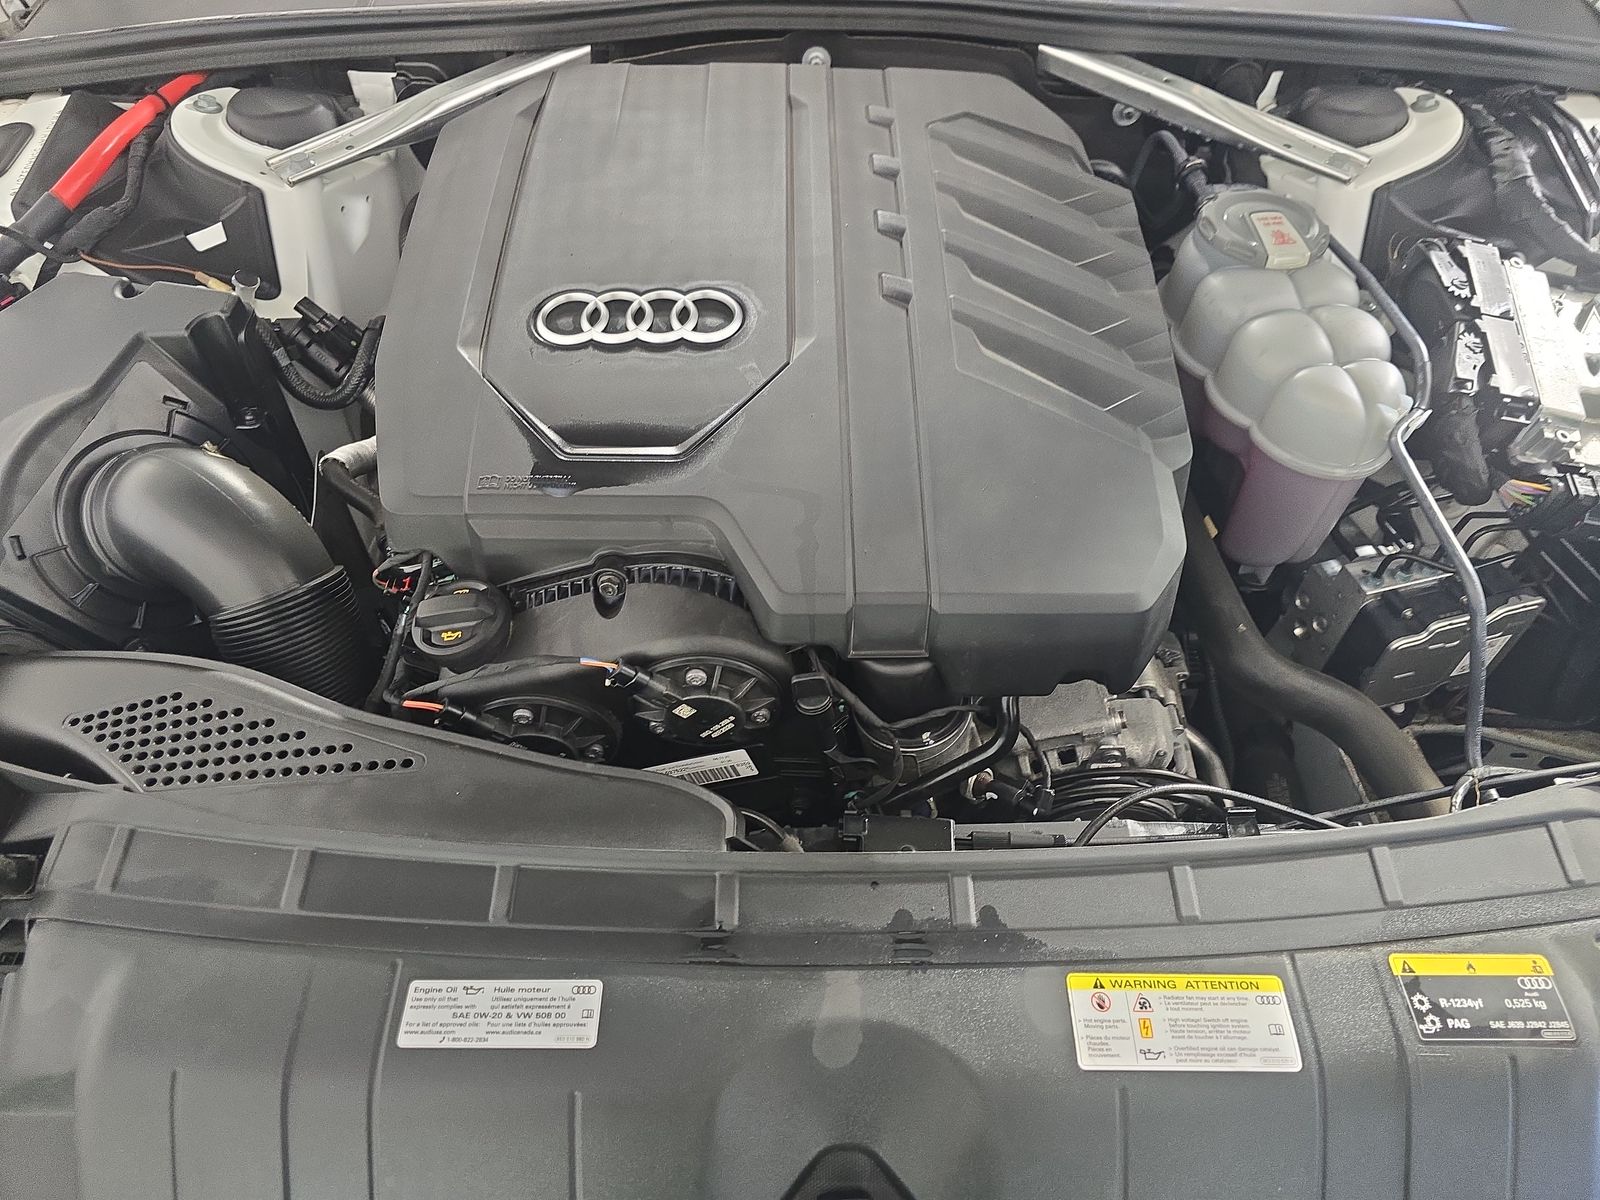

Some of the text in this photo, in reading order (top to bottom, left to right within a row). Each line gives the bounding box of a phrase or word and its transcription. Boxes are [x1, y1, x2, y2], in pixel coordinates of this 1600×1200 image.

[1109, 980, 1260, 990] WARNING ATTENTION
[1438, 998, 1547, 1010] R-1234yf 0,525 kg
[1446, 1018, 1471, 1029] PAG
[1489, 1020, 1506, 1028] SAE
